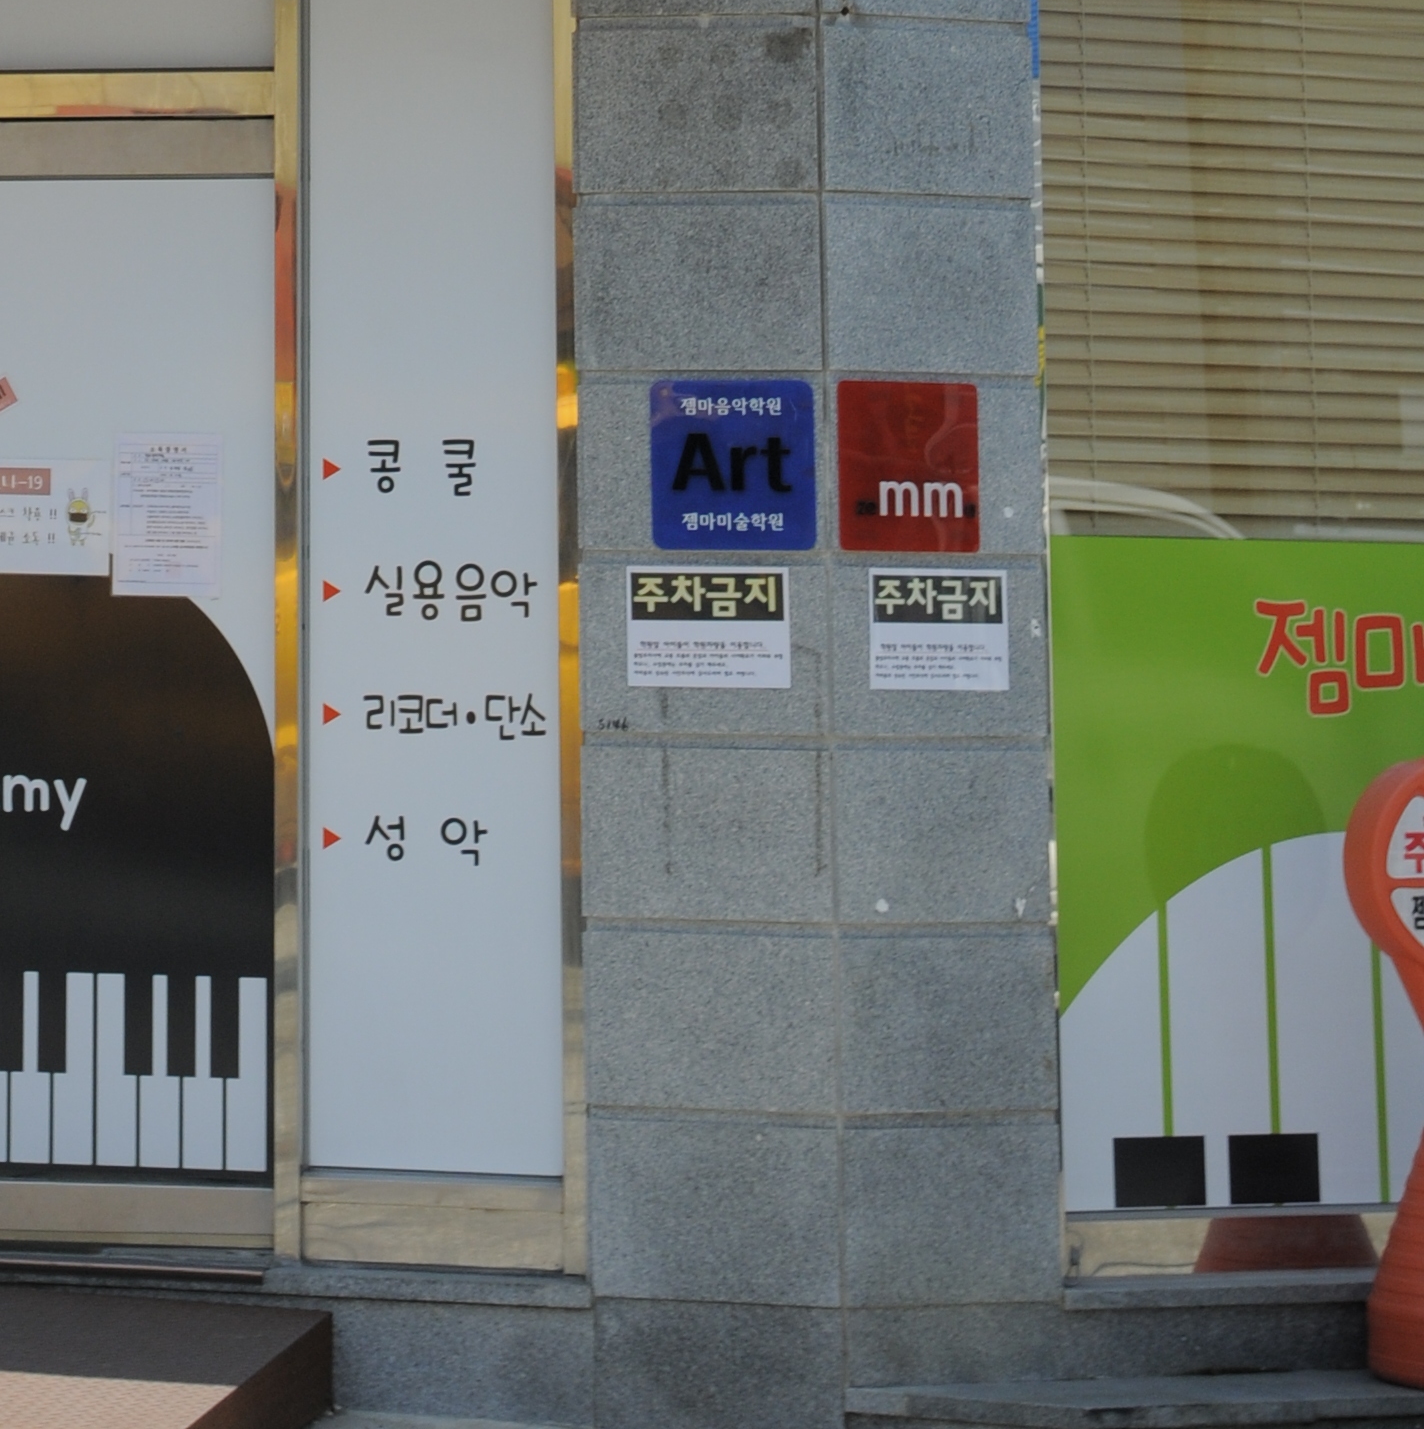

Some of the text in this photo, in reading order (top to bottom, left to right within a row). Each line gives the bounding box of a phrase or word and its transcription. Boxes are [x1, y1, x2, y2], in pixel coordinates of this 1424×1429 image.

[672, 432, 793, 494] Art
[364, 560, 538, 622] 실용음악
[633, 575, 777, 618] 주차금지
[875, 579, 997, 621] 주차금지
